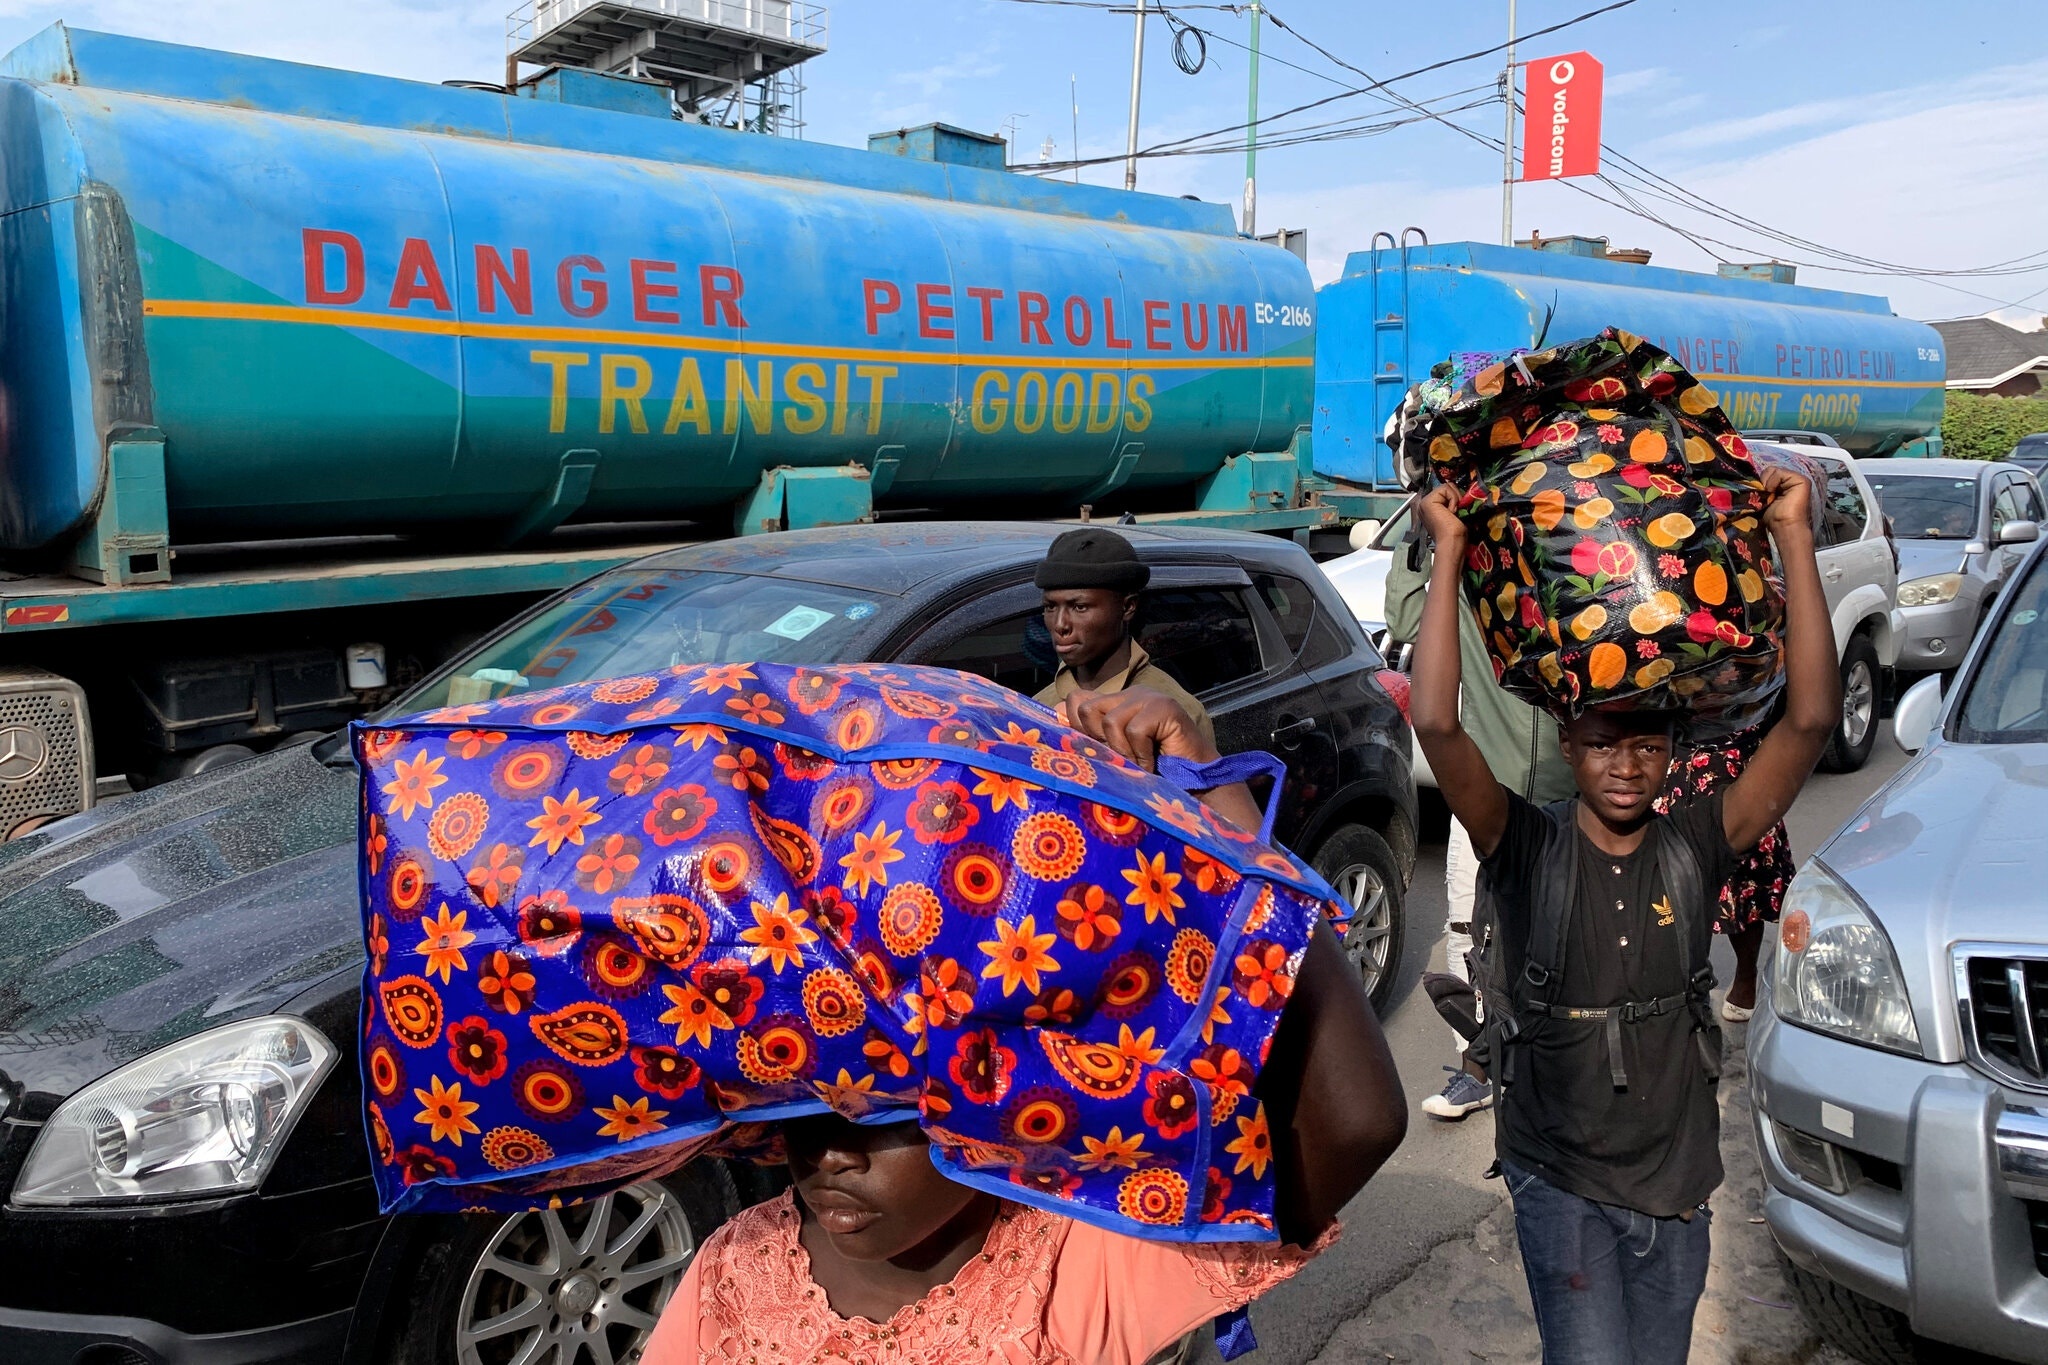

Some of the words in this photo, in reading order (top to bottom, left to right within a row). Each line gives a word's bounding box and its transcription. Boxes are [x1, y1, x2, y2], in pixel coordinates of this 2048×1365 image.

[1549, 88, 1570, 177] vodacom
[302, 227, 749, 329] DANGER
[863, 278, 1249, 353] PETROLEUM
[1254, 302, 1312, 327] EC-2166
[1640, 335, 1740, 374] NGER
[1776, 343, 1896, 380] PETROLEUM
[530, 350, 899, 436] TRANSIT
[971, 369, 1156, 435] GOODS
[1711, 390, 1783, 429] ANSIT
[1798, 392, 1861, 429] GOODS
